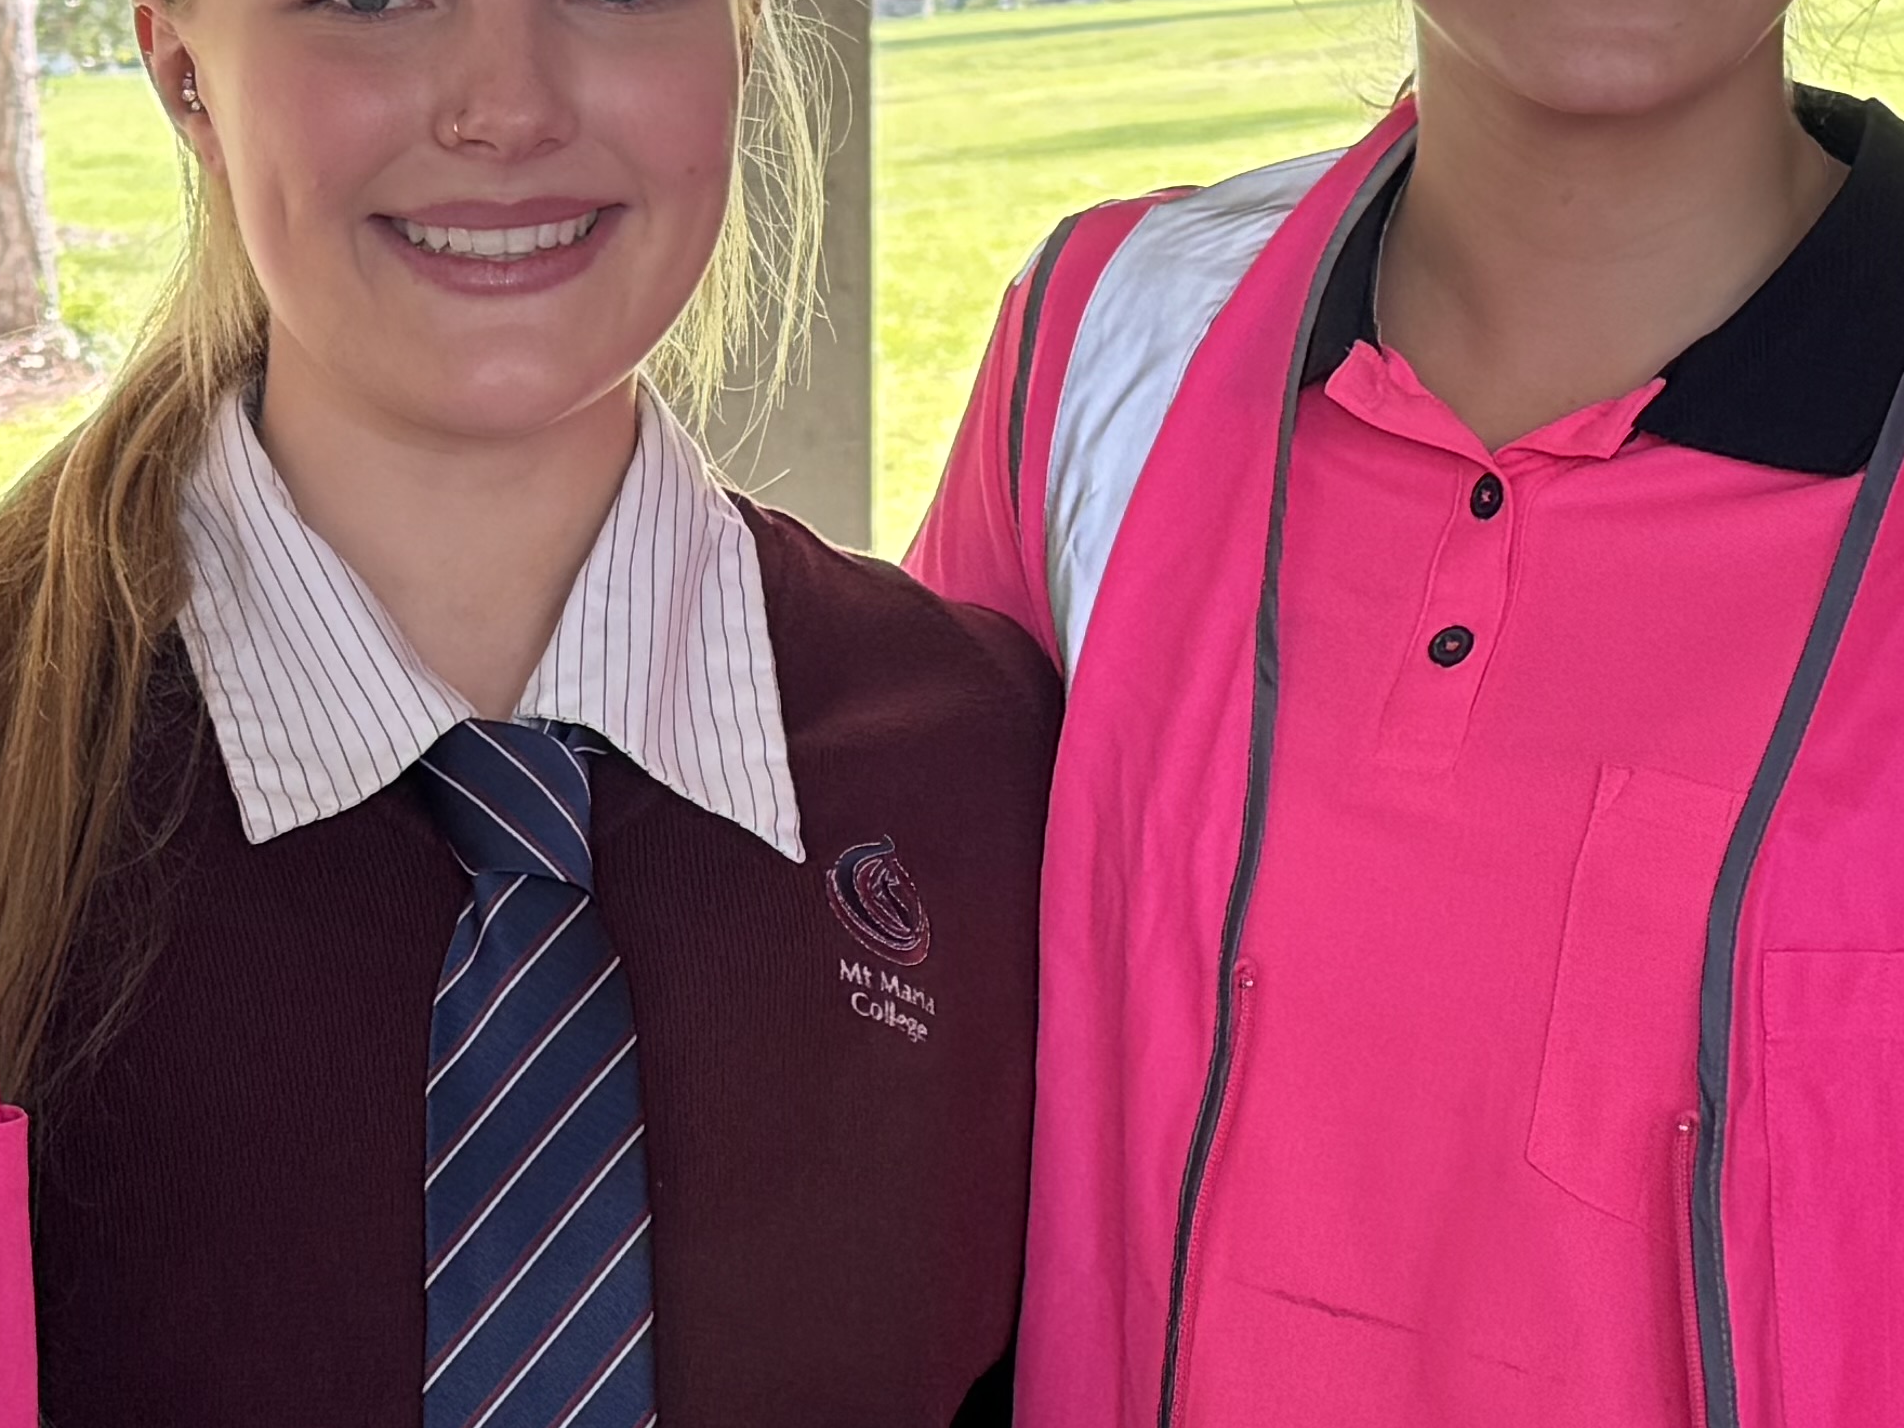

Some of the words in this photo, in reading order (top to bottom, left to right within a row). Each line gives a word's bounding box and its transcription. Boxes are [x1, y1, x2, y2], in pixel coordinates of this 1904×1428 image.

[839, 958, 872, 988] Mt
[880, 970, 936, 1015] Maria
[851, 991, 928, 1043] College
